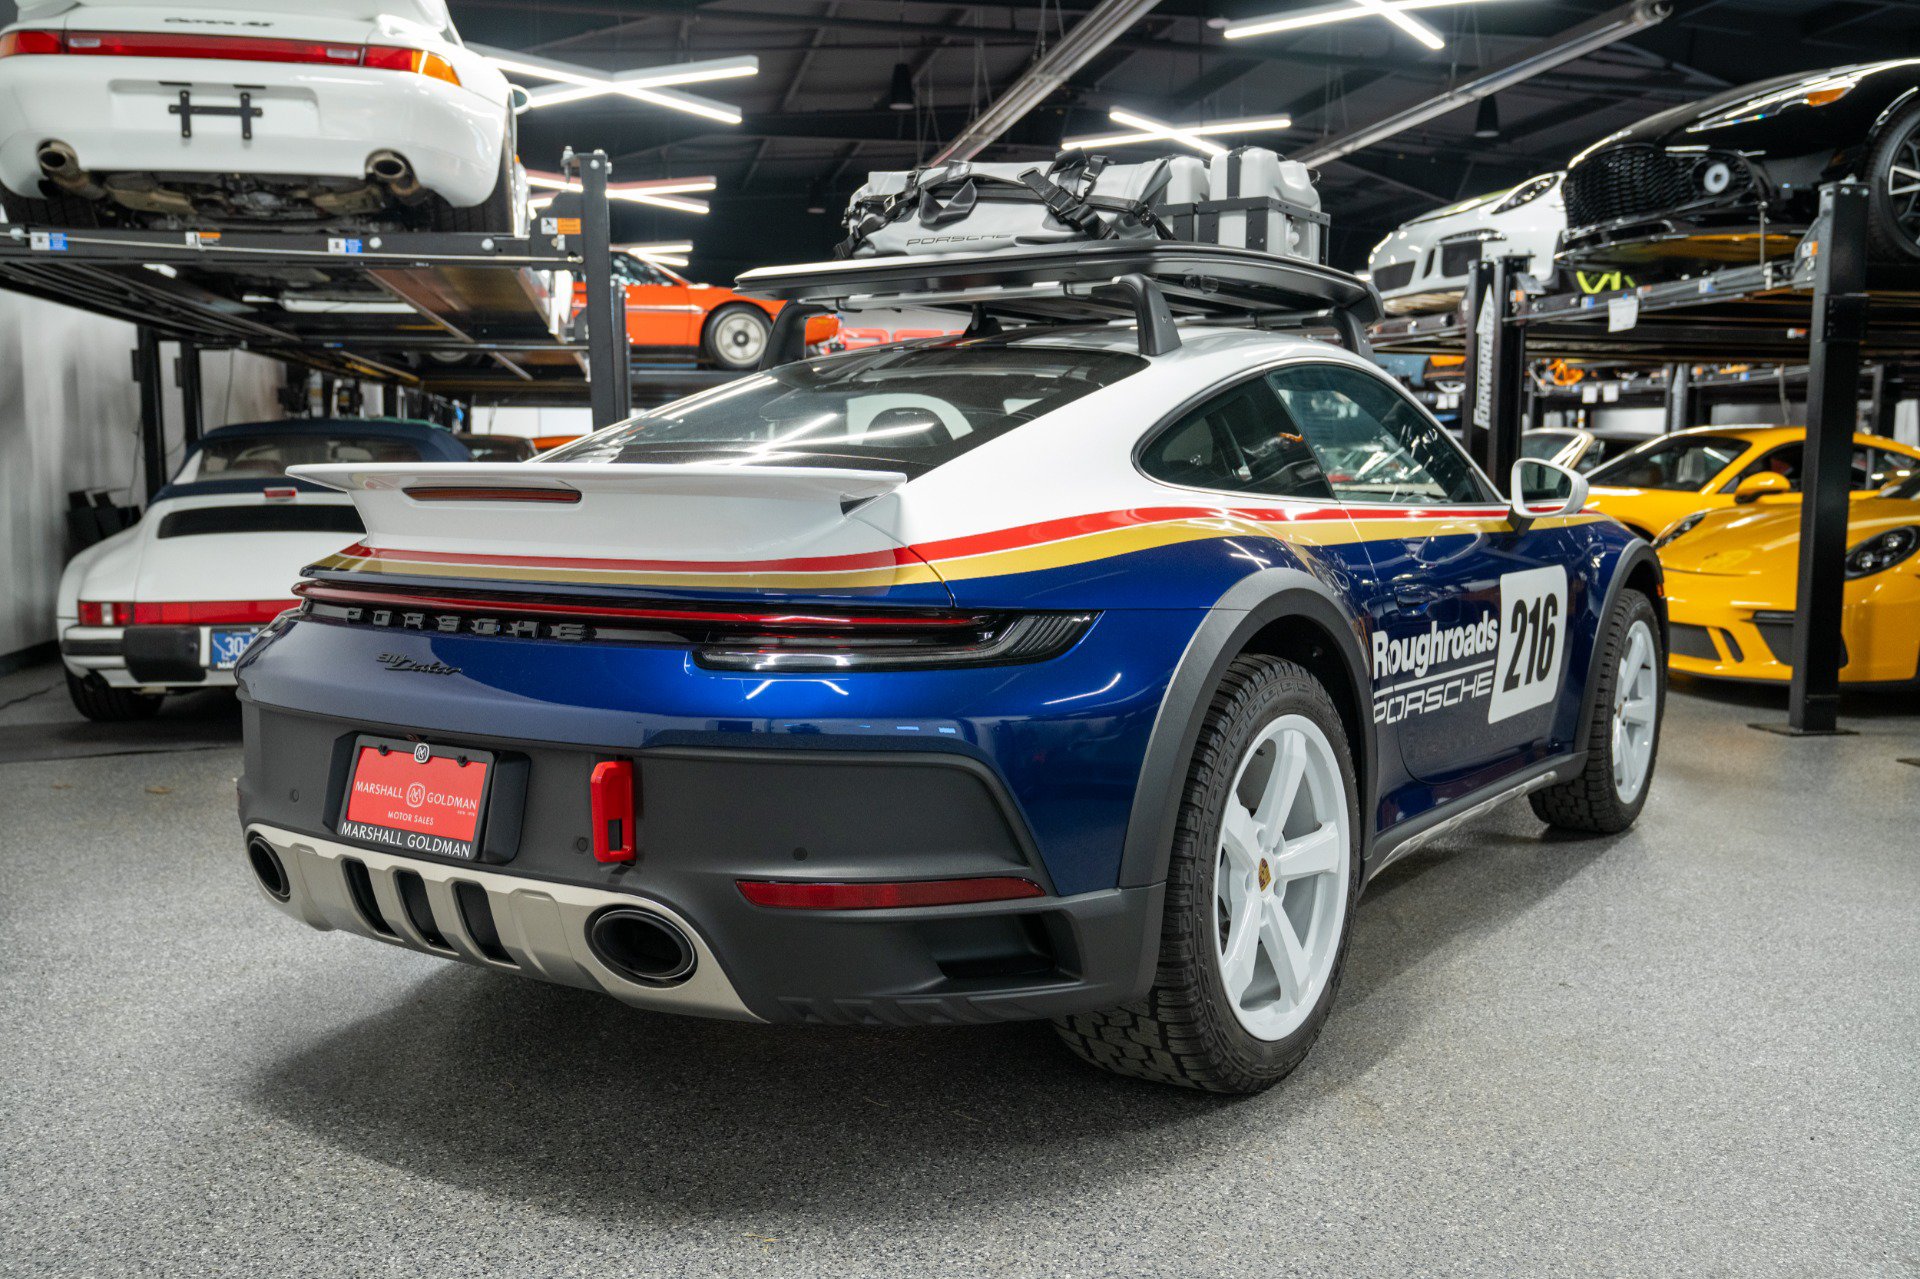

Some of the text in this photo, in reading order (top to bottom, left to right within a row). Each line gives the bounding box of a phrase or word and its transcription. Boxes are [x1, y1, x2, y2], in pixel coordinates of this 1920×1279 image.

[345, 607, 587, 641] PORSCHE
[1372, 610, 1499, 681] Roughroads
[1502, 593, 1558, 694] 216
[1373, 670, 1494, 725] PORSCHE
[355, 781, 403, 799] MARSHALL
[427, 792, 477, 810] GOLDMAN
[388, 810, 434, 826] MOTOR SALES
[341, 822, 471, 858] MARSHALL GOLDMAN
